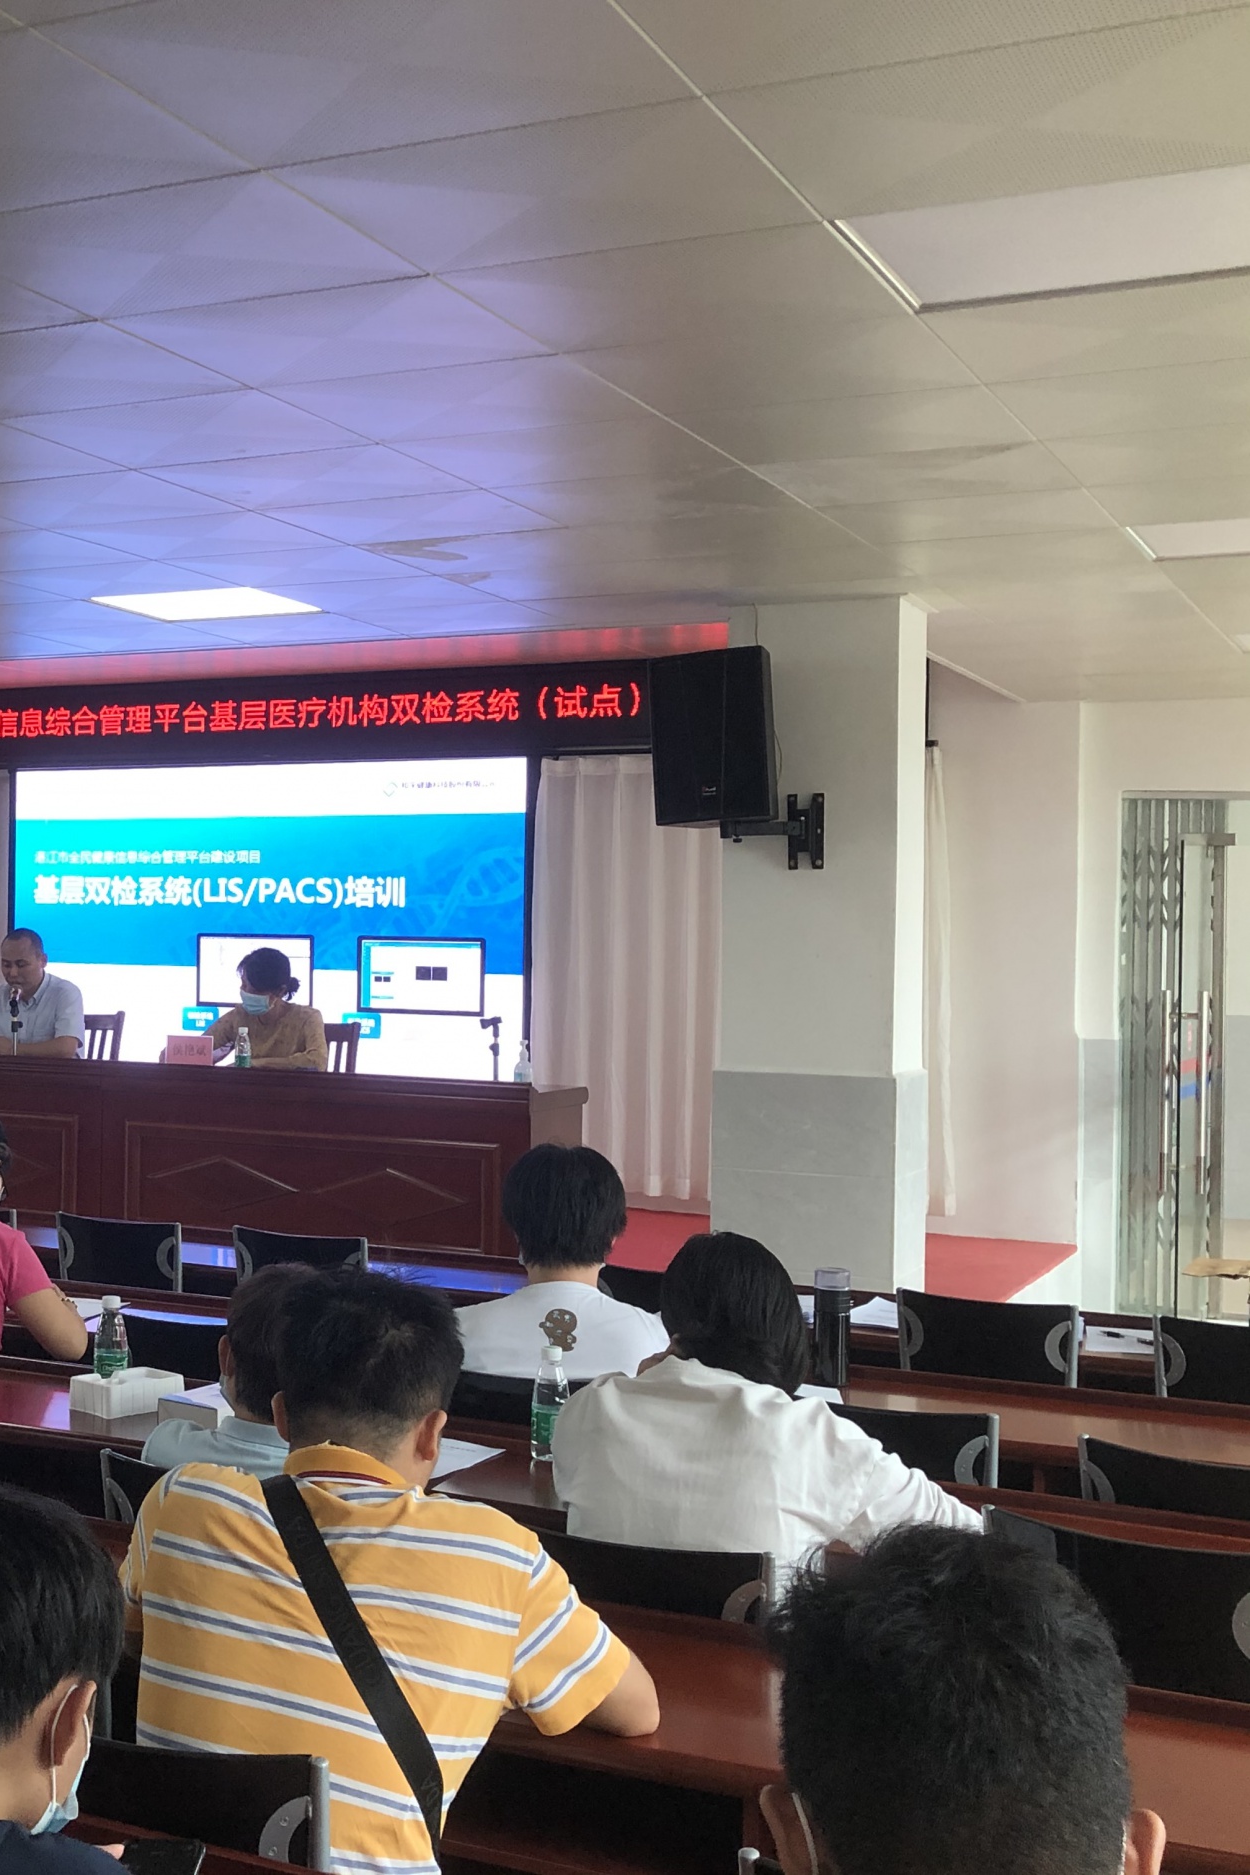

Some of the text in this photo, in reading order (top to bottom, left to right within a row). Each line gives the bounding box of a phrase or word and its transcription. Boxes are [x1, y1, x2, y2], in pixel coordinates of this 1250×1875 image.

[34, 874, 406, 909] 基层双检系统(LIS/PACS)培训
